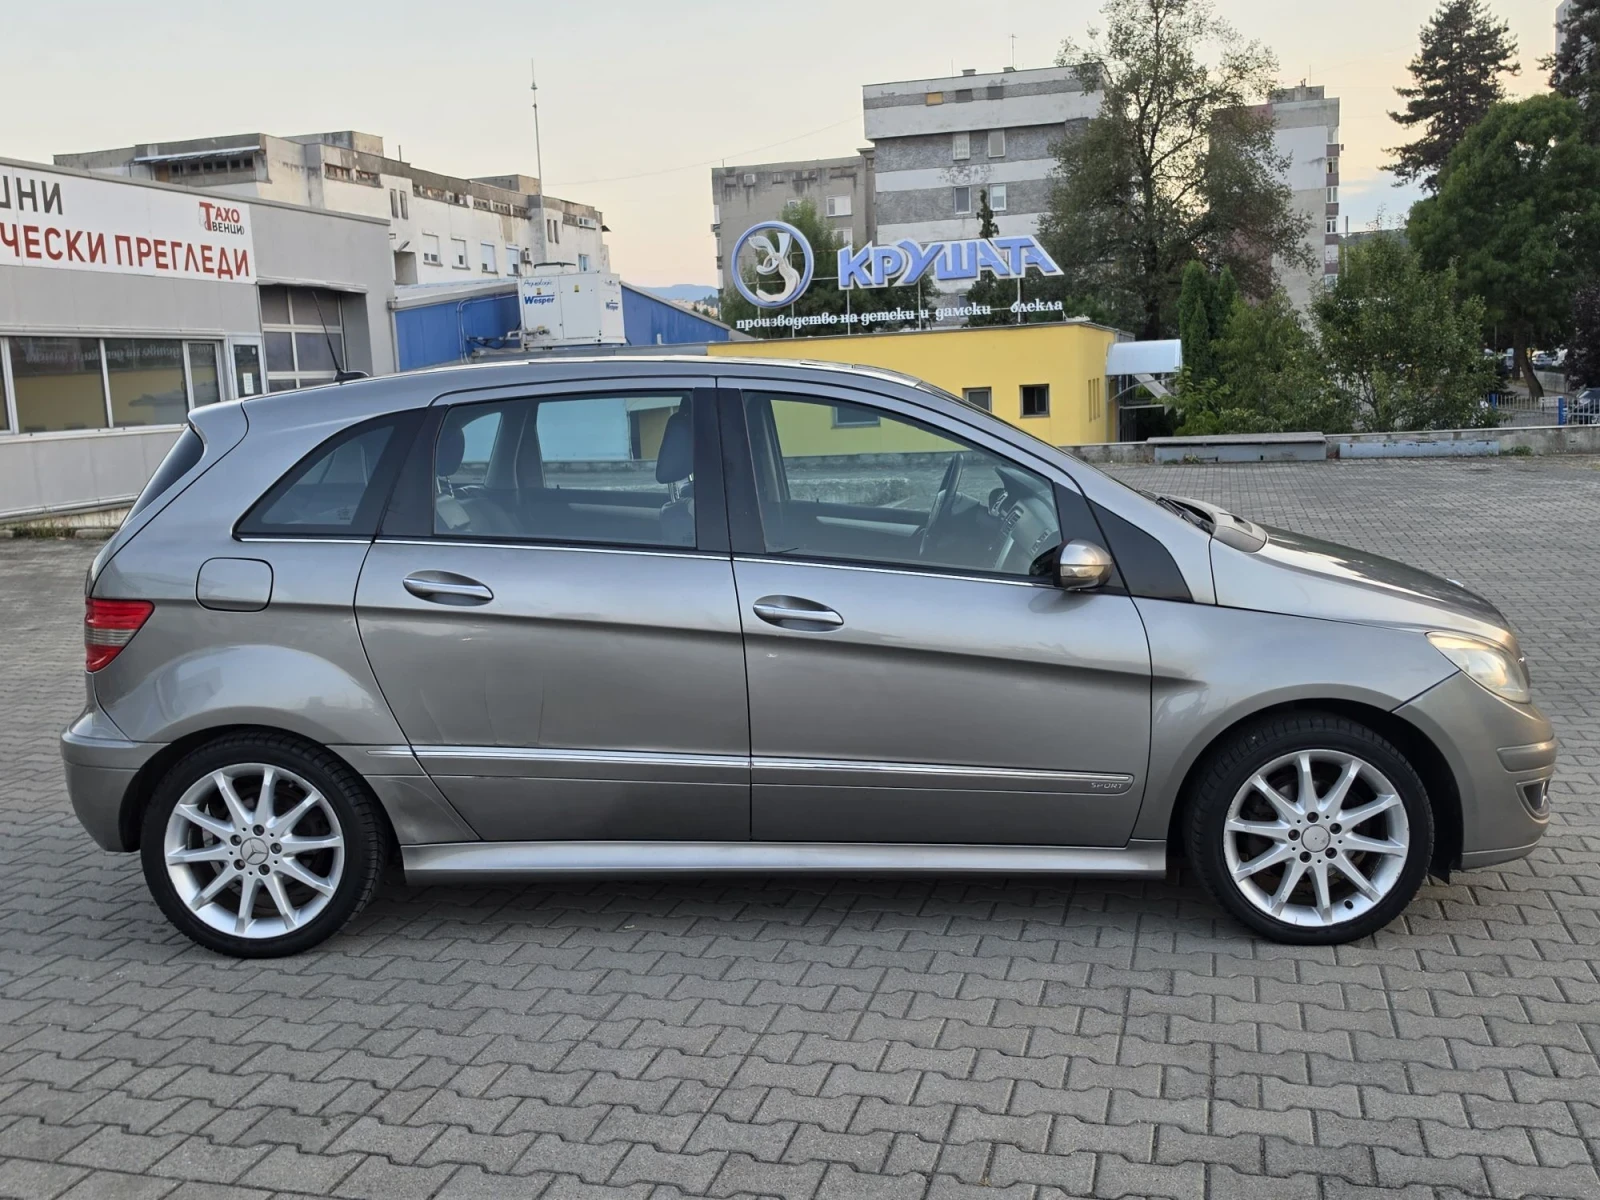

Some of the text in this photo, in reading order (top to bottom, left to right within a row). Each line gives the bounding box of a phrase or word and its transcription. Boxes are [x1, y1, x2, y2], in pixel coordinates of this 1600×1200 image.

[199, 202, 240, 231] ТАХО
[212, 221, 244, 235] ВЕНЦИ
[0, 223, 249, 280] ЧЕСКИ ПРЕГЛЕДИ
[838, 234, 1065, 290] КРУШАТА
[524, 295, 555, 305] Wesper
[840, 312, 858, 324] на
[919, 309, 929, 319] и
[935, 302, 991, 321] дамски
